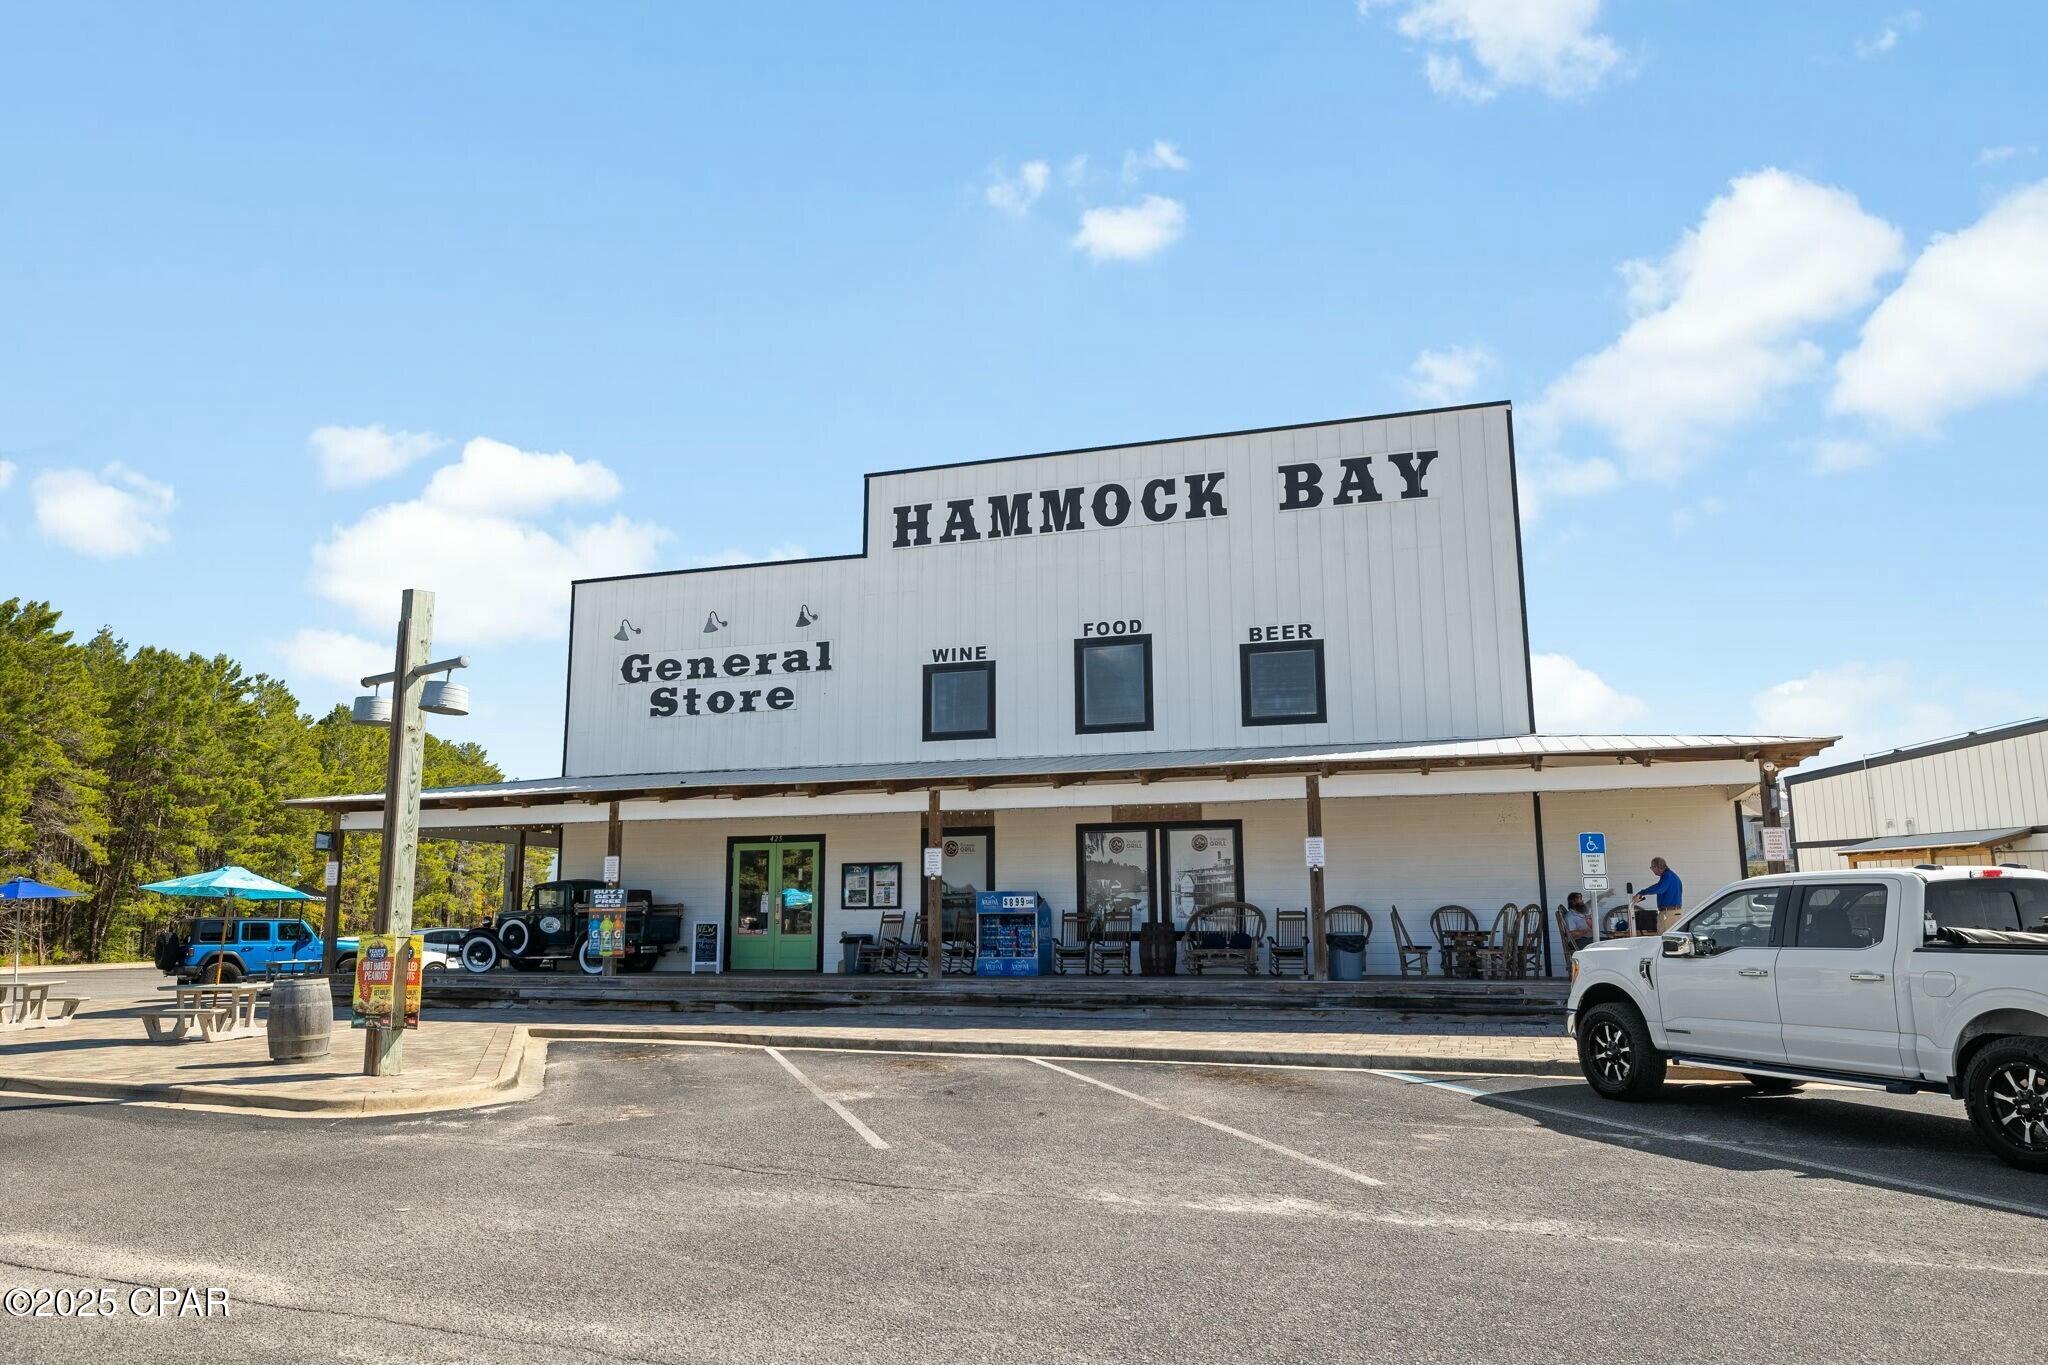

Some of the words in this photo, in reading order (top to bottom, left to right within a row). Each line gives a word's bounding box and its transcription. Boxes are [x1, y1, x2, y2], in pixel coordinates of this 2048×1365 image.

[893, 472, 1228, 549] HAMMOCK
[1278, 451, 1439, 511] BAY
[1083, 619, 1142, 637] FOOD
[1249, 624, 1312, 643] BEER
[620, 641, 832, 684] General
[932, 645, 987, 663] WINE
[650, 686, 795, 717] Store
[362, 962, 373, 970] HOT
[374, 962, 391, 970] BOILED
[364, 970, 388, 980] PEANUTS
